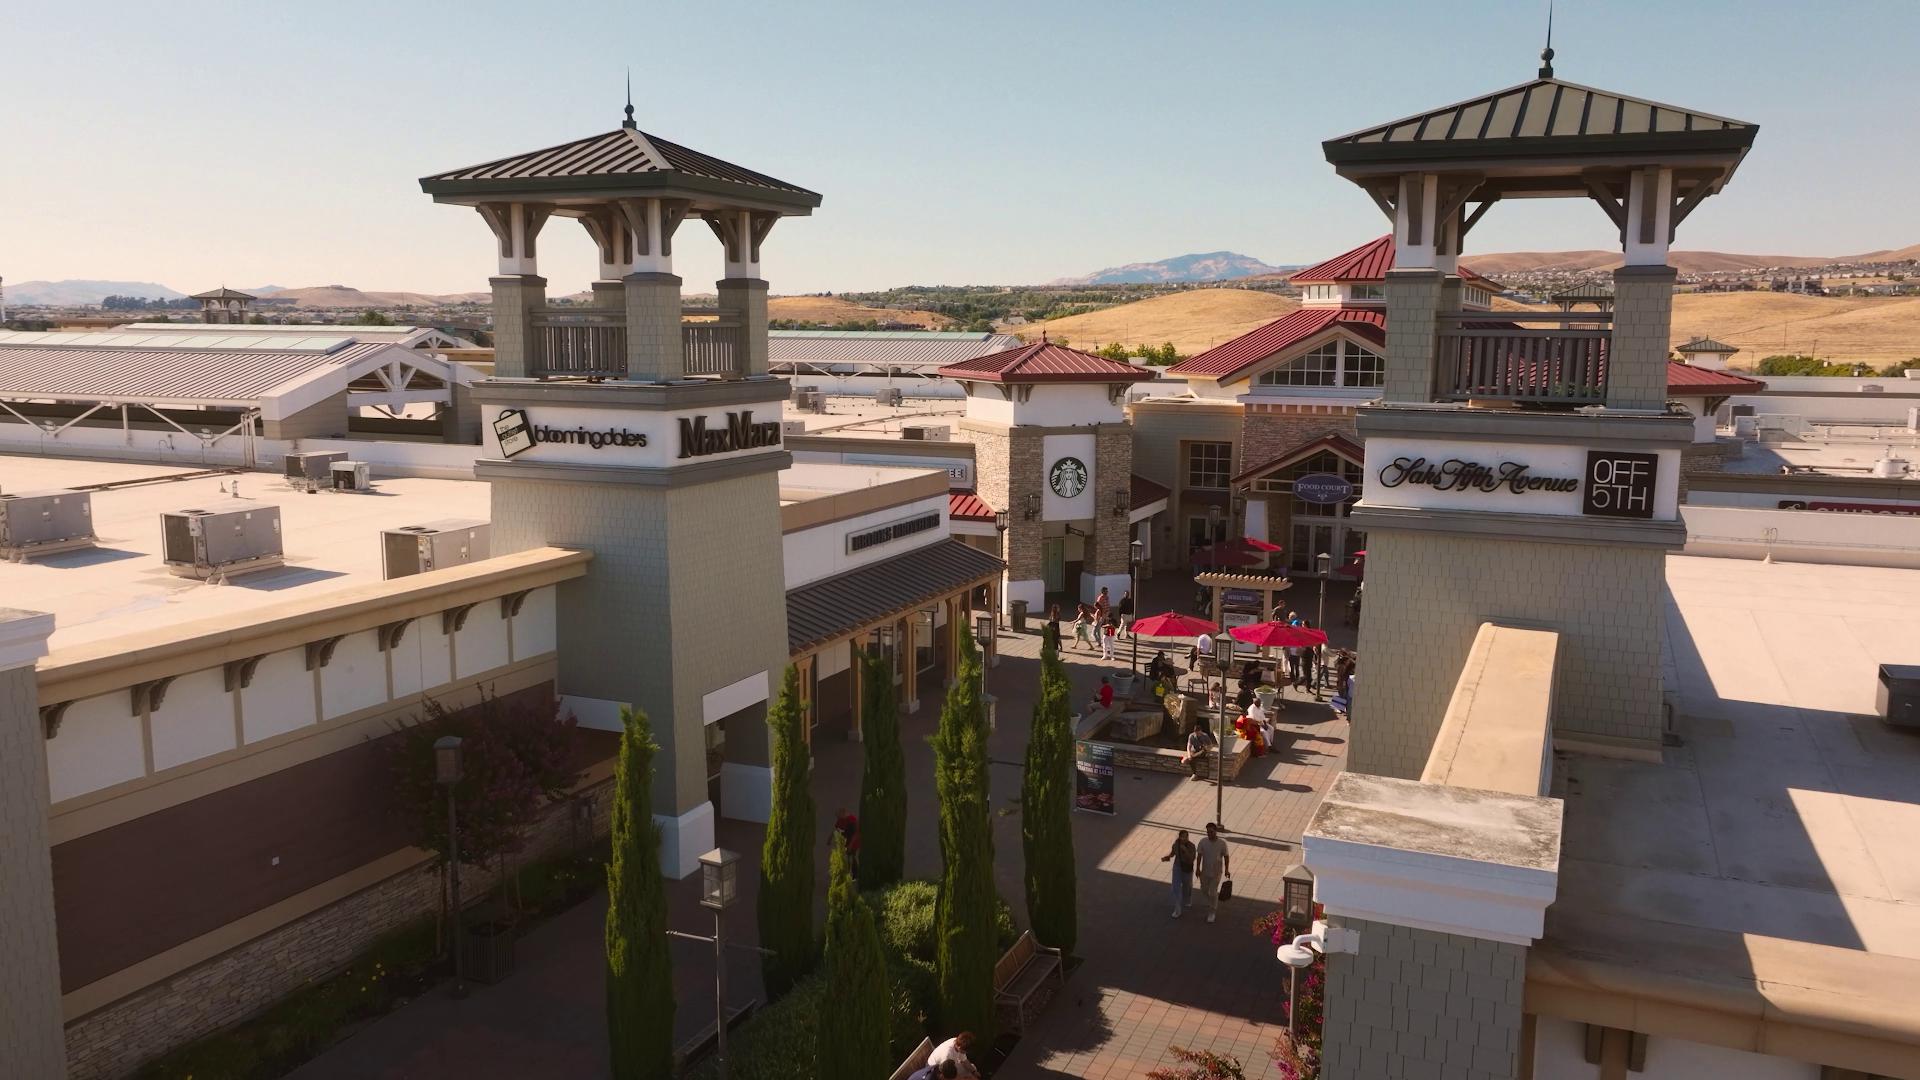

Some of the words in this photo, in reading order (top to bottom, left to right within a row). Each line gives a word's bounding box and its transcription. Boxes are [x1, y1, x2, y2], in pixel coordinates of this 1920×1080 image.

[1379, 457, 1442, 488] Saks
[1436, 459, 1494, 492] Fifth
[1488, 462, 1578, 495] Avenue
[1593, 459, 1649, 484] OFF
[1297, 483, 1320, 492] FOOD
[1321, 485, 1349, 494] COURT
[1592, 484, 1647, 511] 5TH
